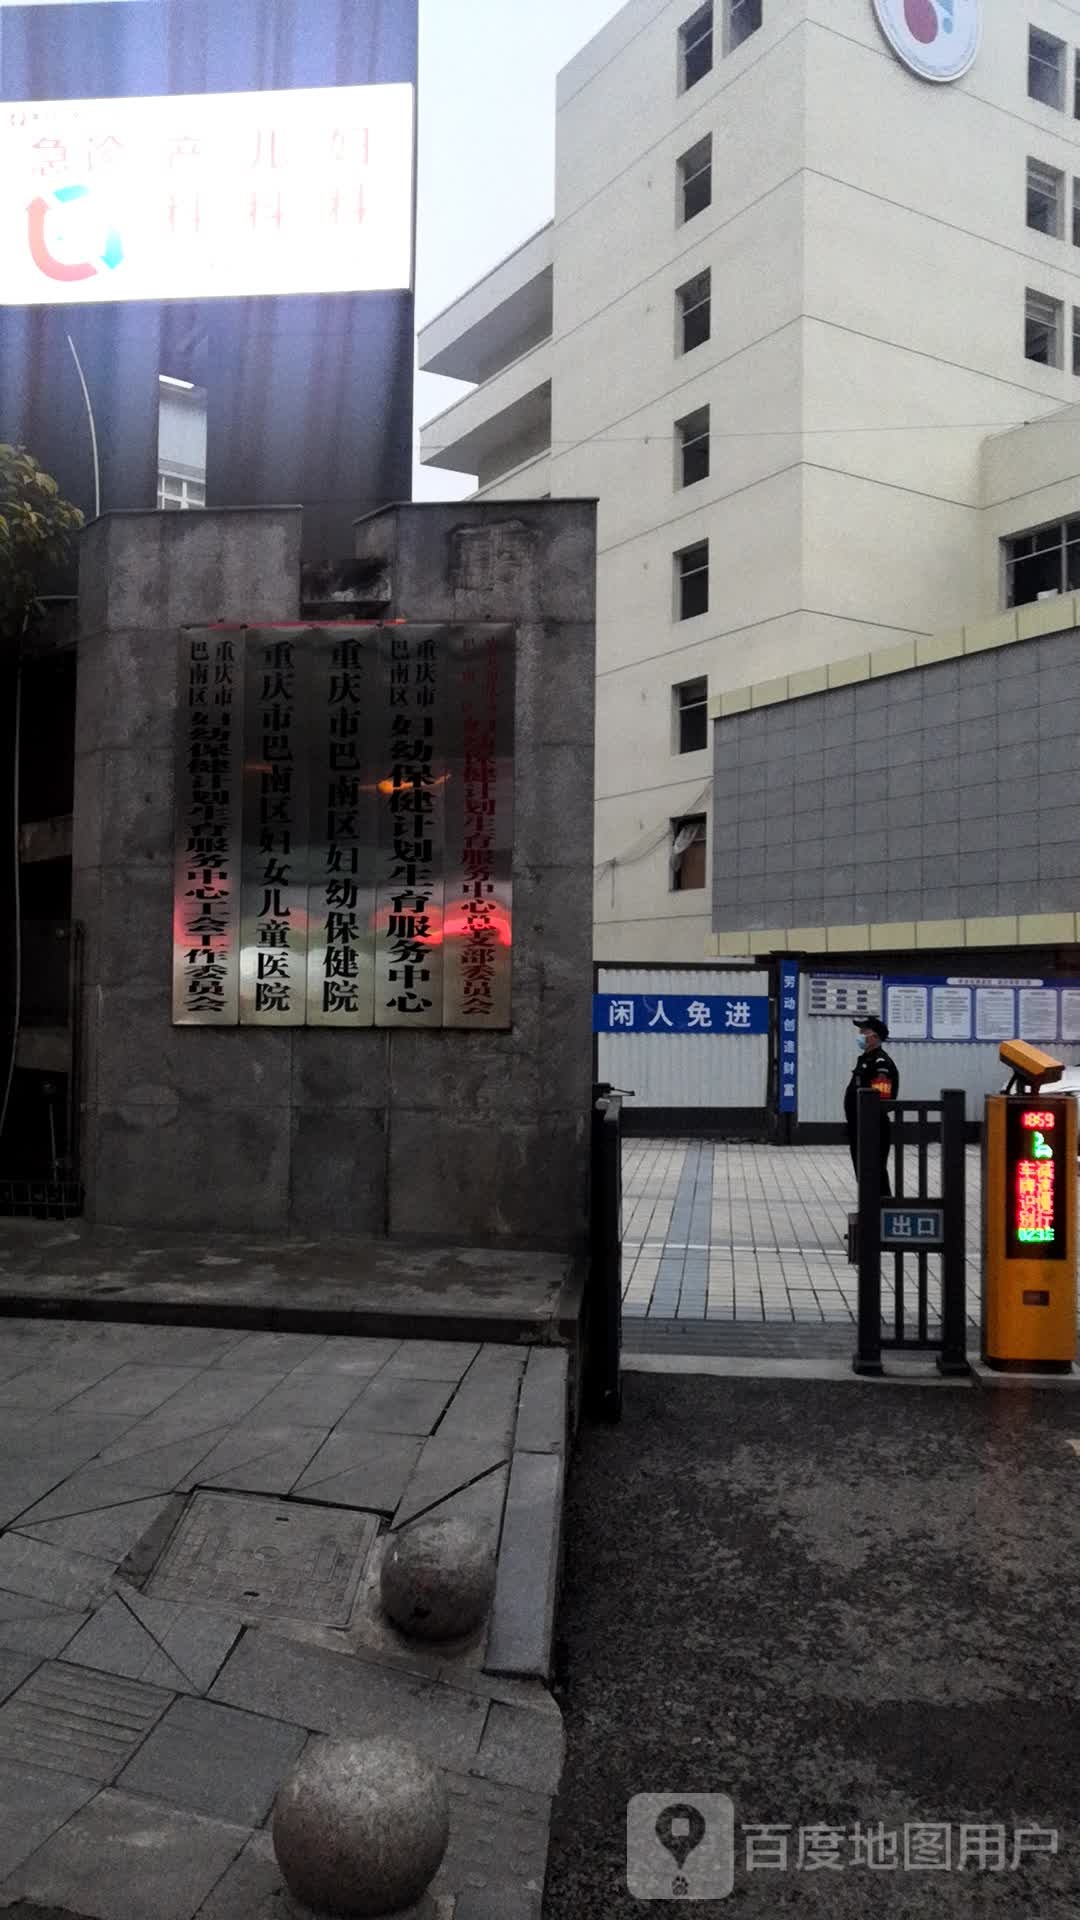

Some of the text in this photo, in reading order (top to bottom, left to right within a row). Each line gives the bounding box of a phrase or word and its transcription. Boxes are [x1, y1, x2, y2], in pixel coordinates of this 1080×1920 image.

[389, 639, 409, 708] 巴南区
[416, 639, 438, 708] 重庆市
[255, 640, 296, 1013] 重庆市巴南区妇女儿童医院
[322, 638, 364, 1014] 重庆市巴南区妇幼保健院
[609, 1000, 751, 1027] 闲人免进
[892, 1214, 935, 1236] 出口
